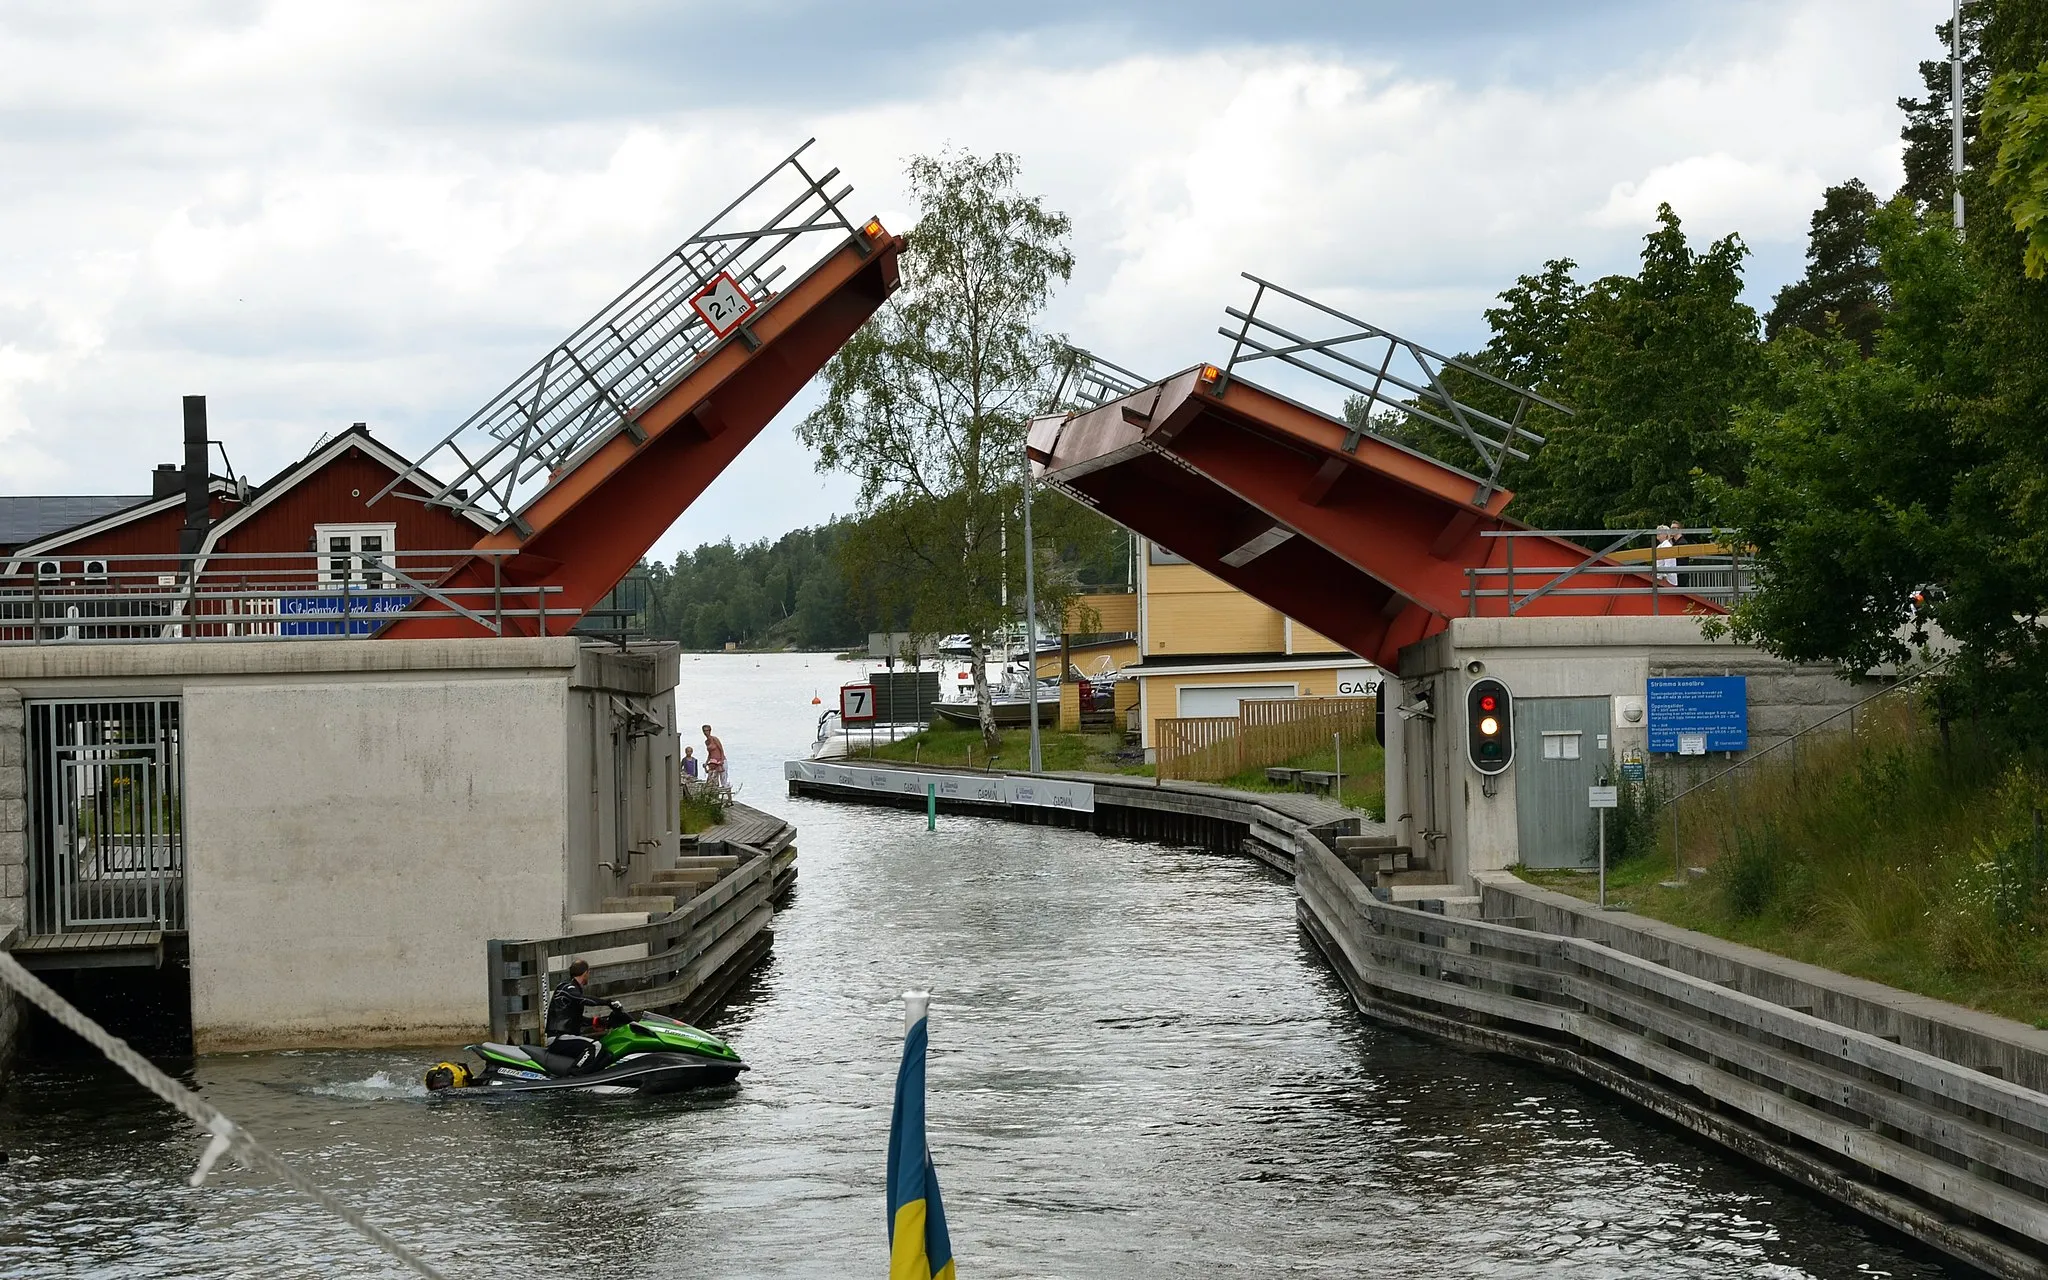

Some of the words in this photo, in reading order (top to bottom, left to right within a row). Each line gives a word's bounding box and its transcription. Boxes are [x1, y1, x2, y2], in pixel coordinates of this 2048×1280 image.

[709, 295, 735, 320] 2,7
[738, 304, 748, 314] m
[850, 692, 866, 714] 7
